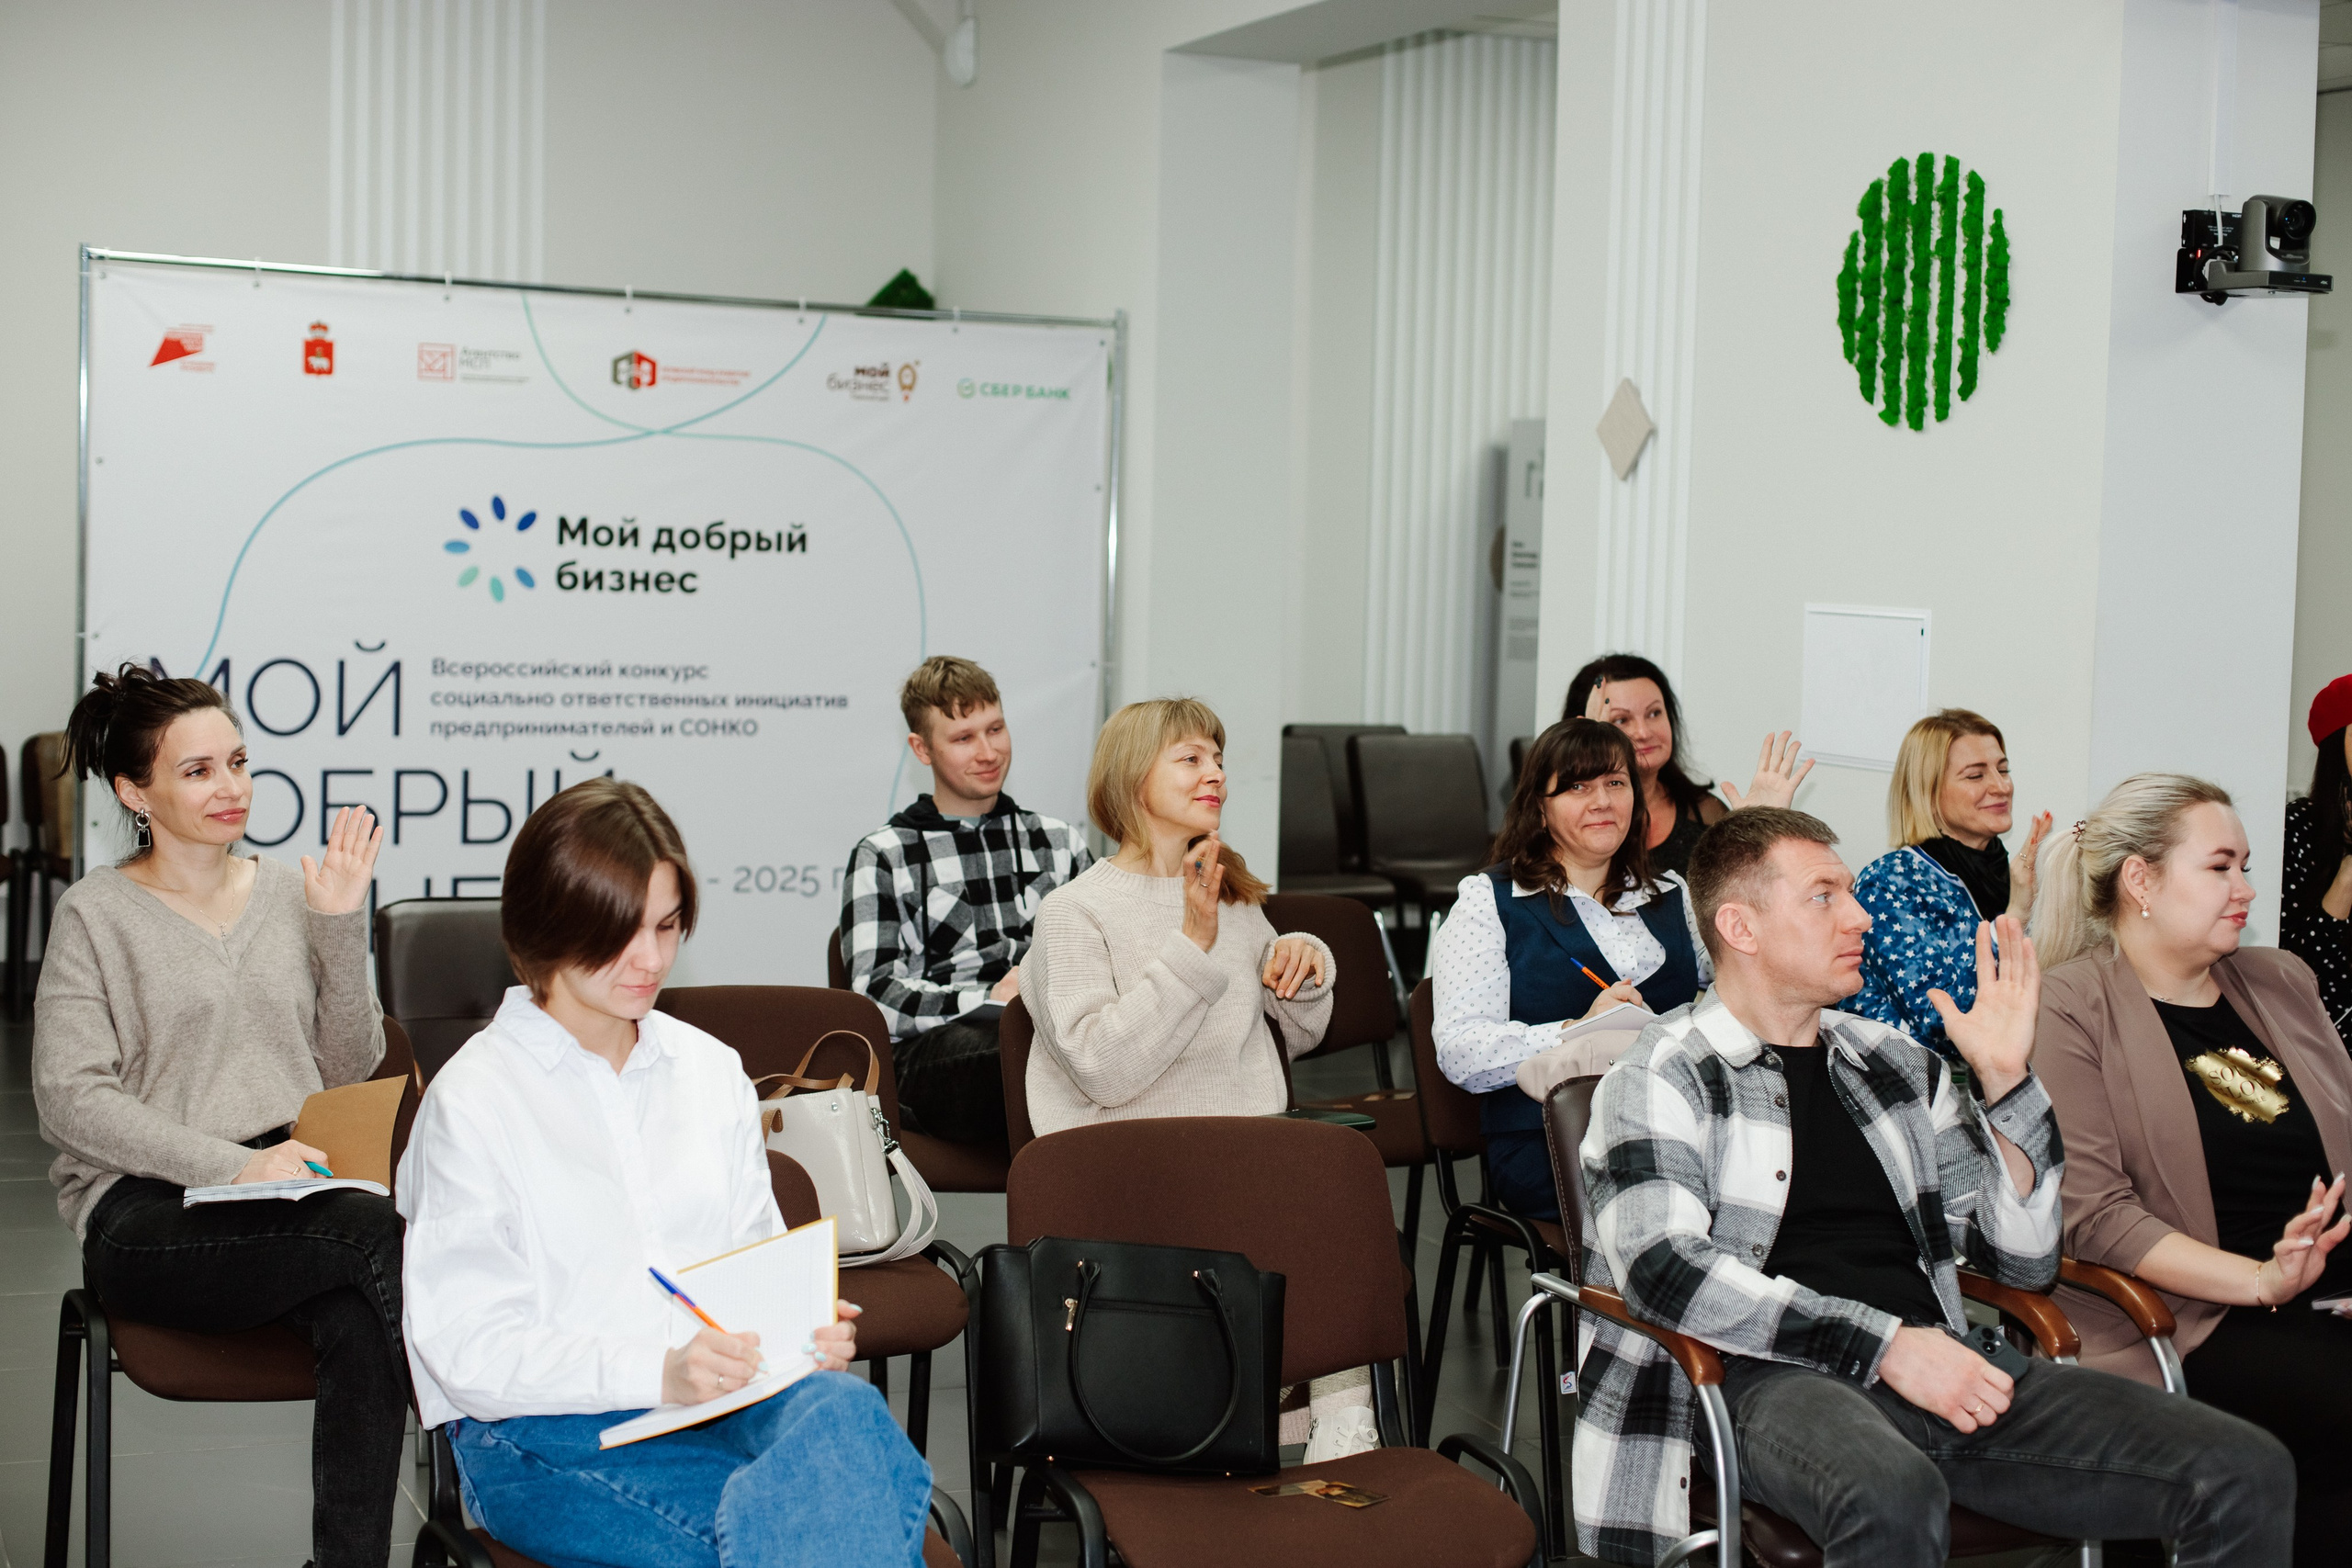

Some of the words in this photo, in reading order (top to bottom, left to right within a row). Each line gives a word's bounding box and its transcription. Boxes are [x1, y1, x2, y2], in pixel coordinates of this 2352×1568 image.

[558, 515, 639, 548] Мой
[651, 520, 807, 560] добрый
[556, 560, 698, 593] бизнес
[431, 658, 614, 682] Всероссийский
[618, 662, 709, 683] конкурс
[430, 691, 555, 708] социально
[560, 692, 729, 709] ответственных
[735, 694, 849, 710] инициатив
[430, 718, 655, 741] предпринимателей
[661, 722, 674, 735] и
[680, 718, 759, 736] СОНКО
[733, 865, 820, 897] 2025
